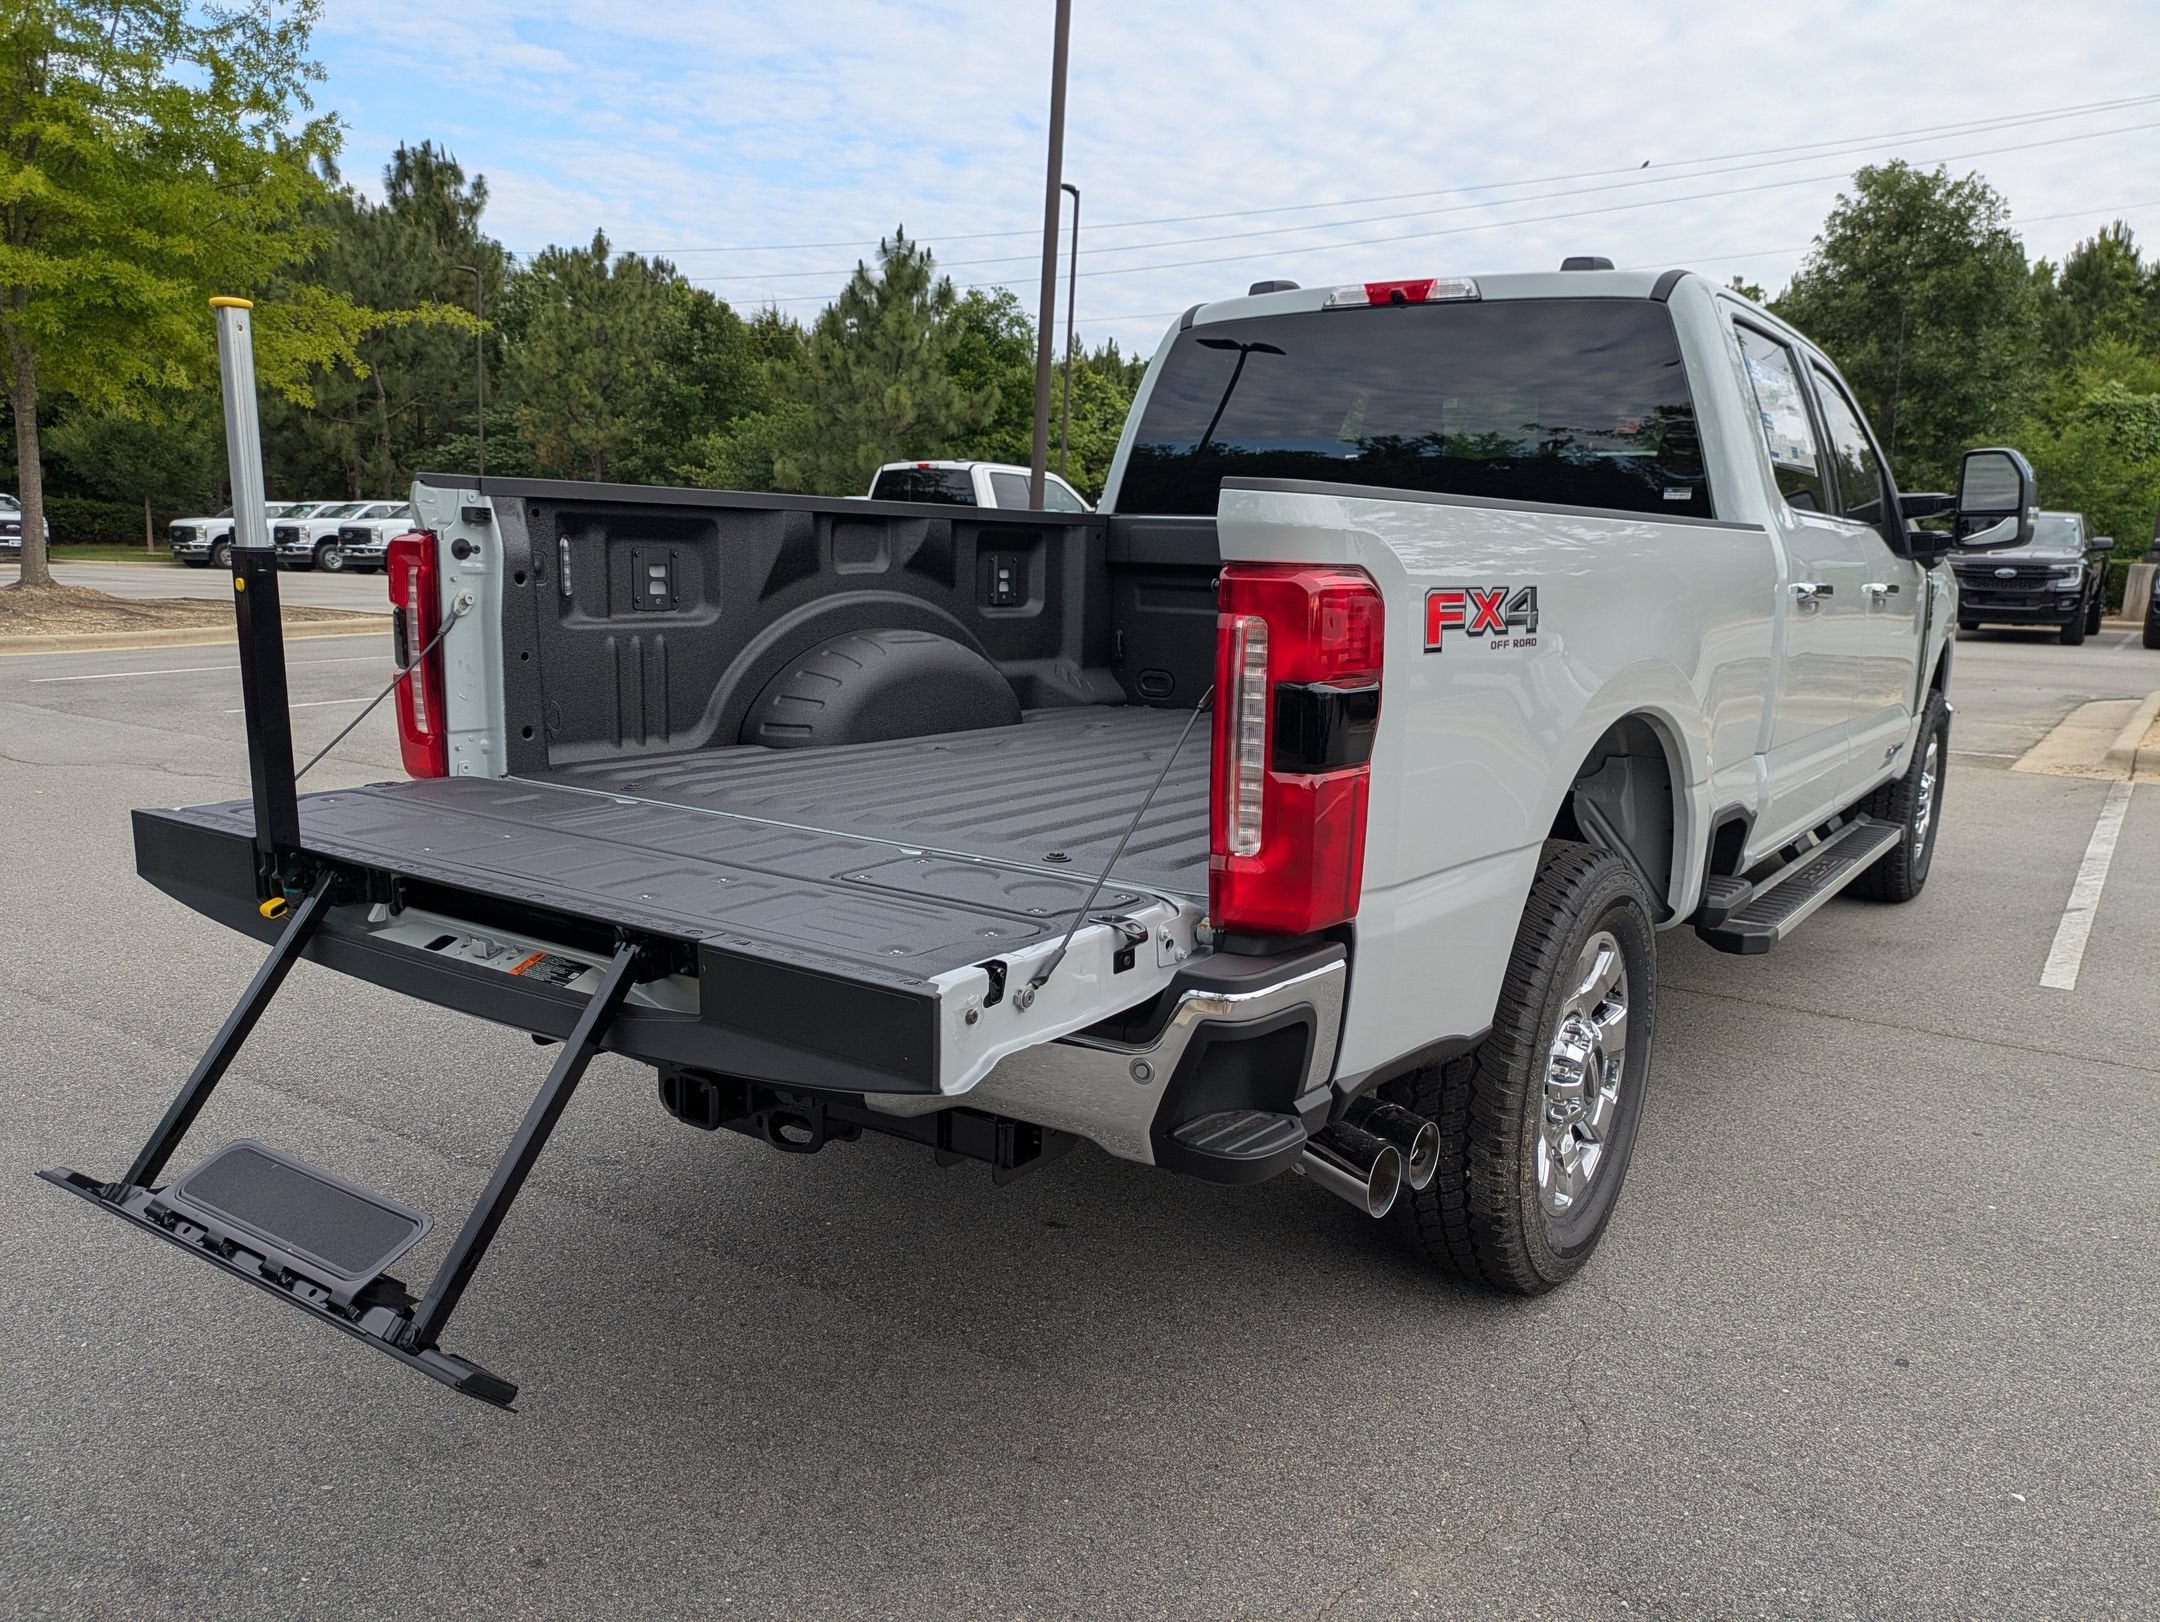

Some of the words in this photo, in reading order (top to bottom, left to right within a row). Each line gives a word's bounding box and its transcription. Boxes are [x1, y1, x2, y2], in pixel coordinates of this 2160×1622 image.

[1424, 586, 1538, 654] FX4
[1490, 640, 1510, 650] OFF
[1513, 638, 1537, 648] ROAD
